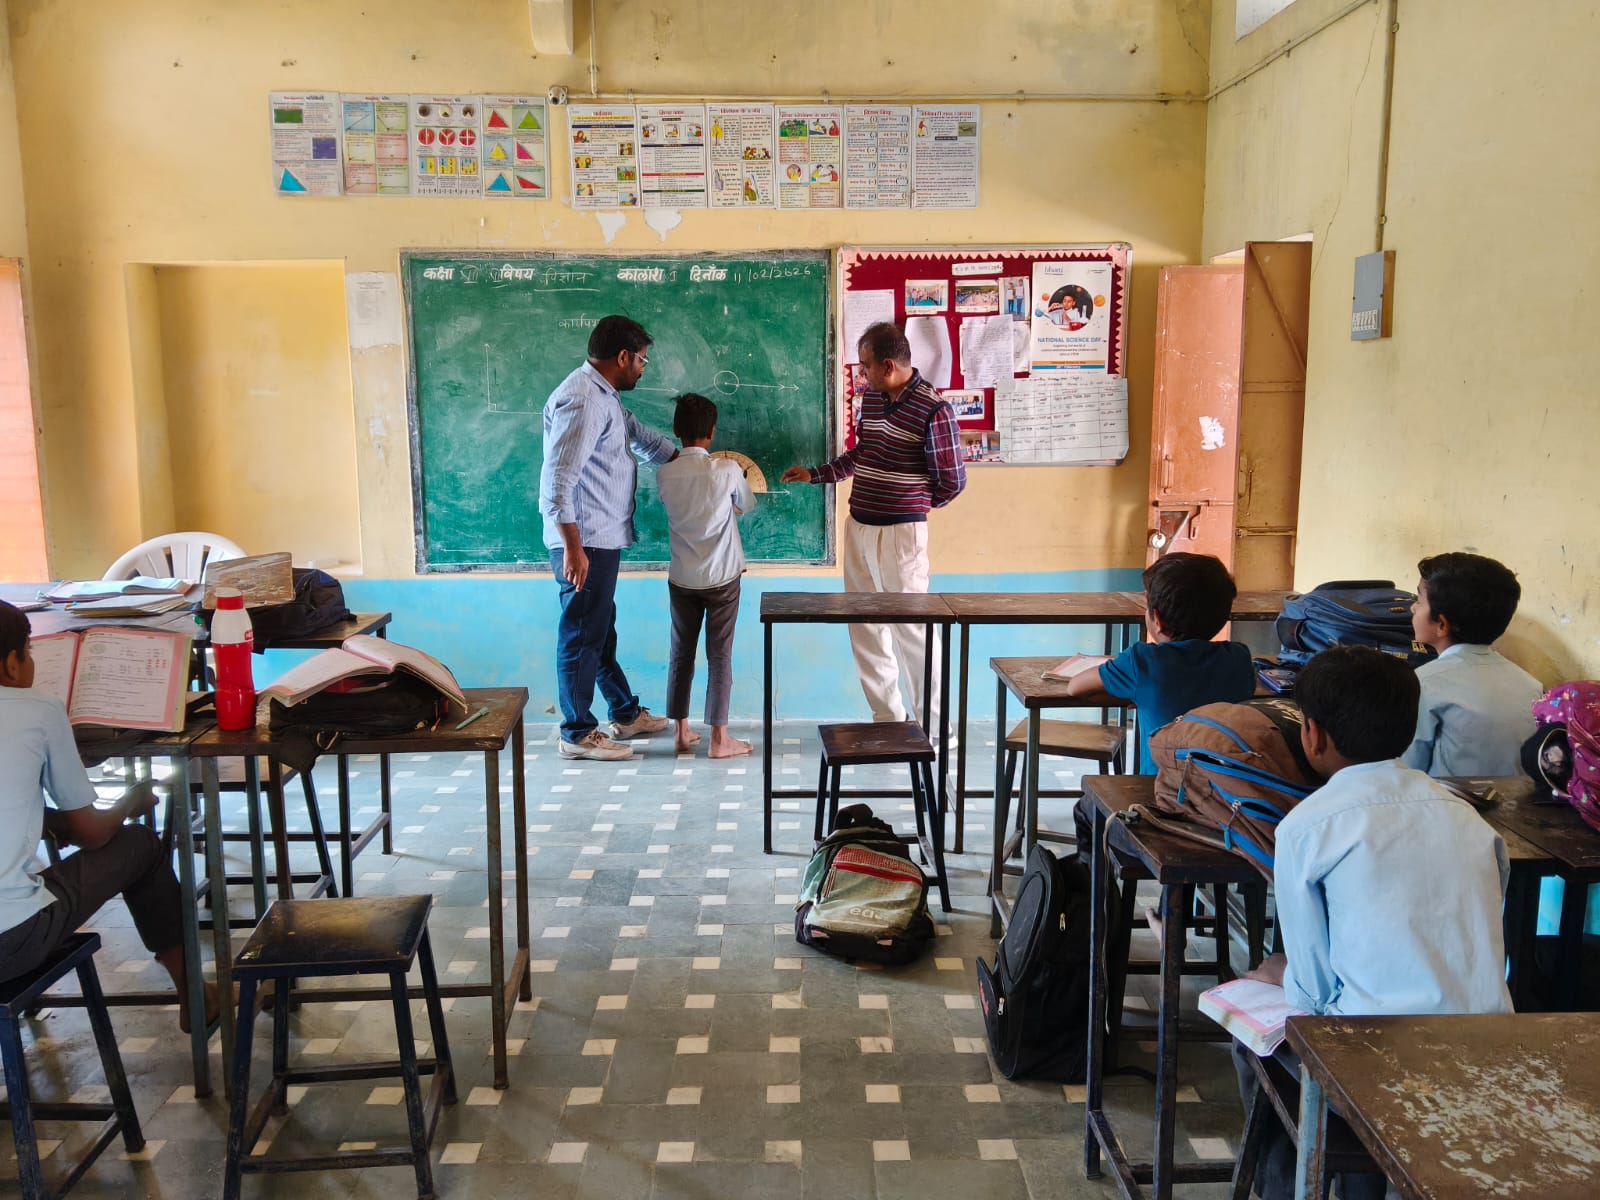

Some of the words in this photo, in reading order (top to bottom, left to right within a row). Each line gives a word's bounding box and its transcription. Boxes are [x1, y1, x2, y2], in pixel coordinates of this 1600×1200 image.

[423, 265, 456, 281] कक्षा
[500, 263, 535, 281] विषय
[541, 267, 594, 286] विज्ञान
[616, 265, 665, 282] कालांश
